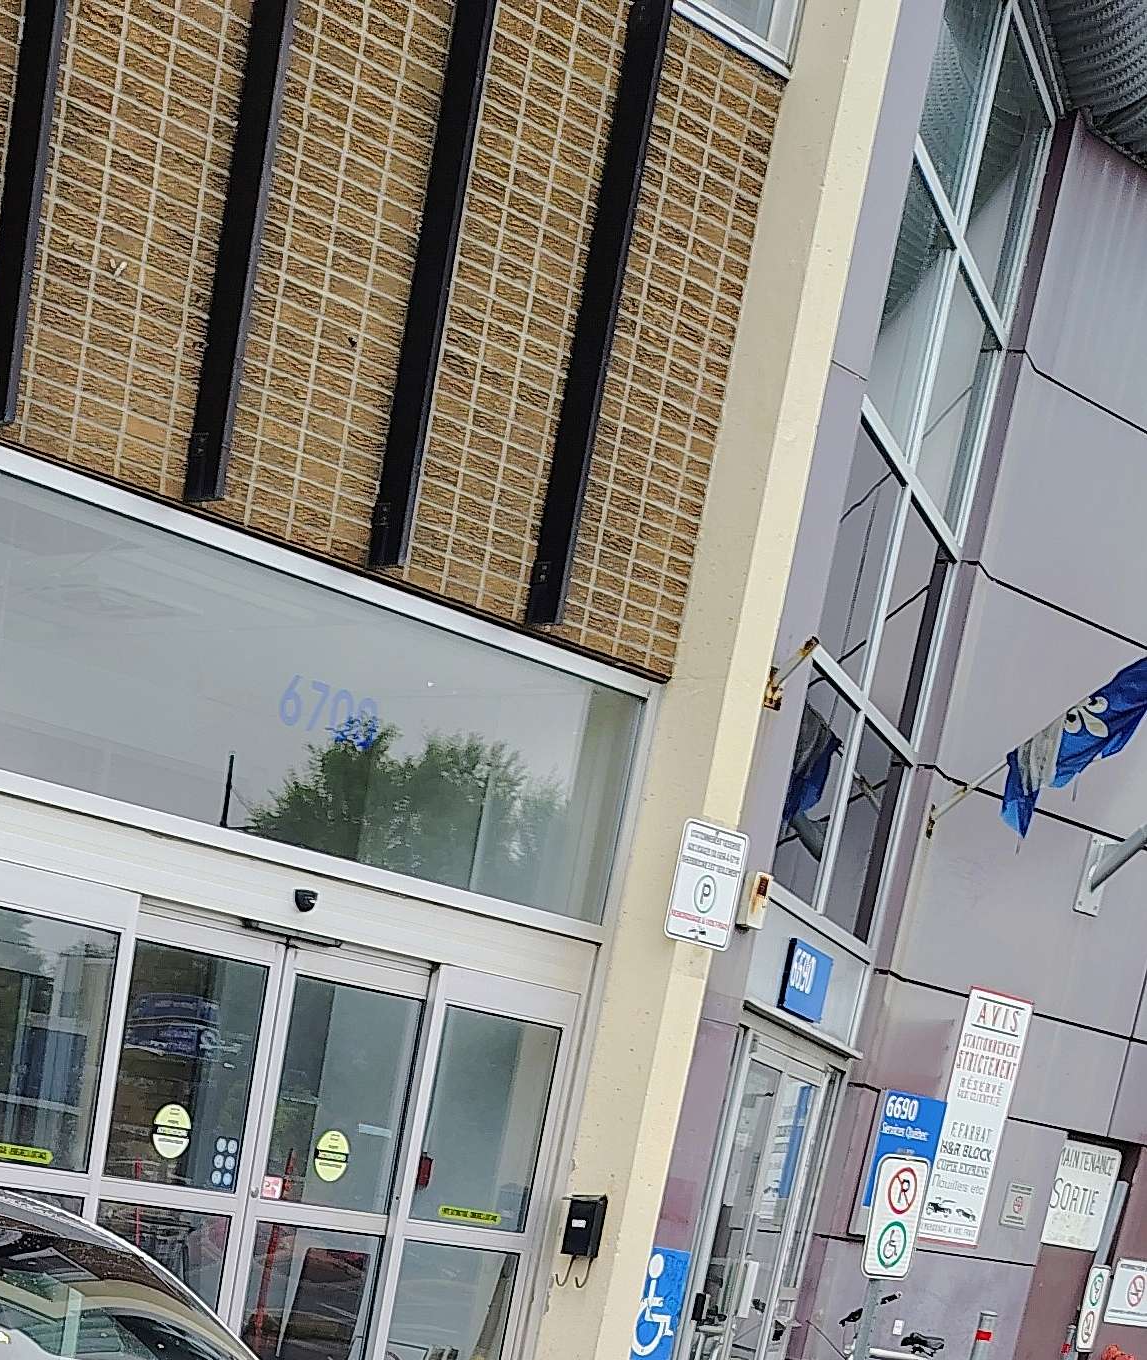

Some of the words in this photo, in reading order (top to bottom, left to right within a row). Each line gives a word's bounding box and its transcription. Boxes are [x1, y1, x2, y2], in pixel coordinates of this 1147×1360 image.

[976, 1002, 1021, 1033] AVIS
[886, 1095, 919, 1121] 6690
[940, 1139, 961, 1156] H&R
[962, 1144, 993, 1163] BLOCK
[1050, 1177, 1100, 1215] SORTIE
